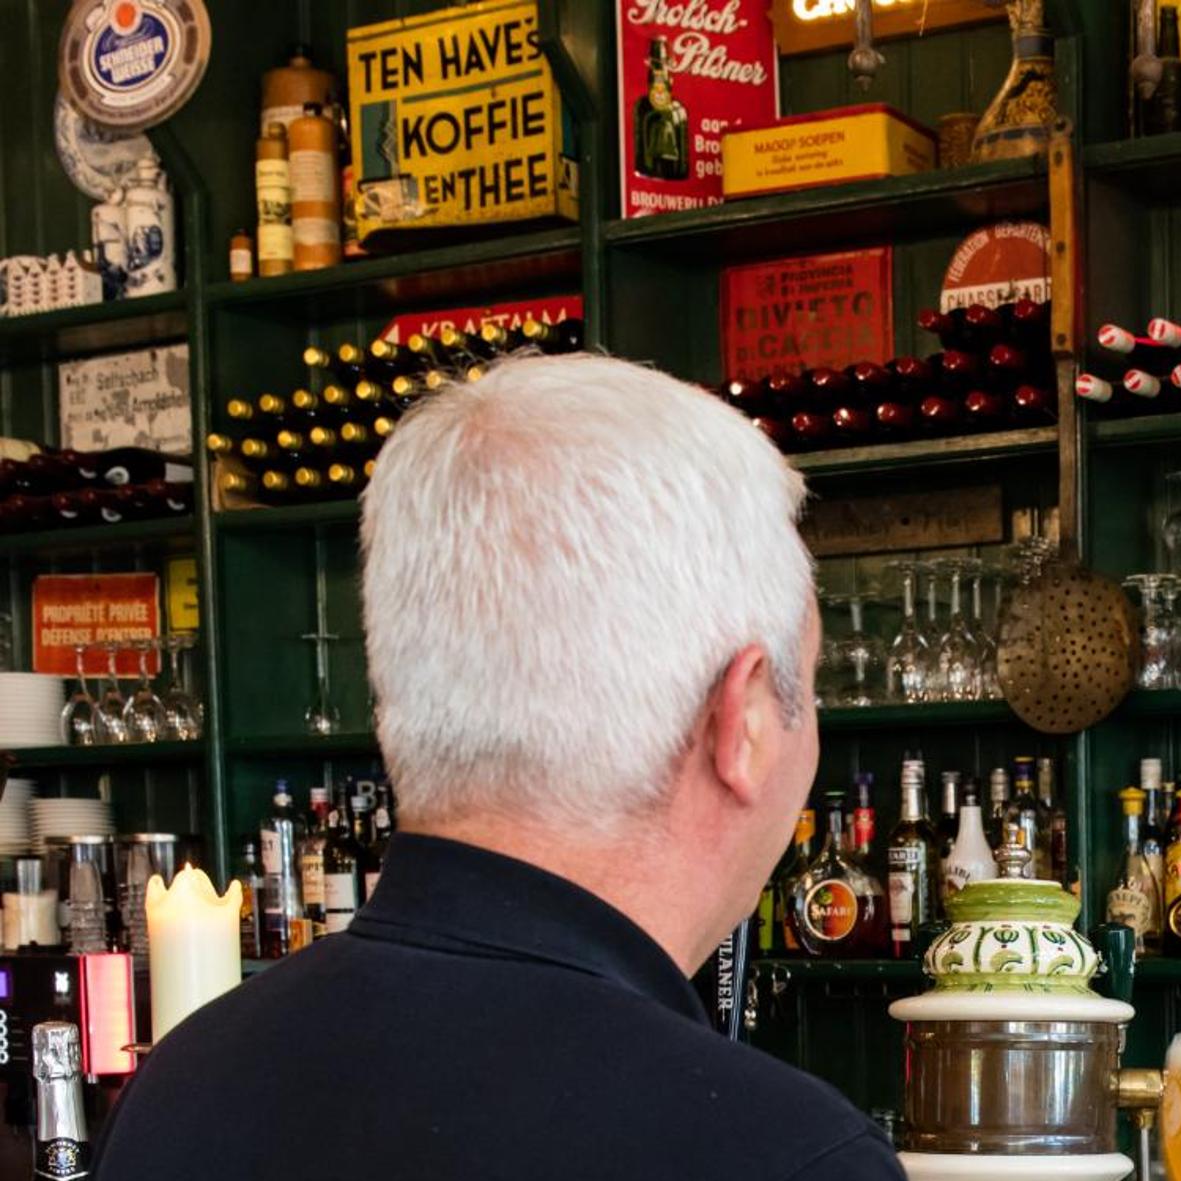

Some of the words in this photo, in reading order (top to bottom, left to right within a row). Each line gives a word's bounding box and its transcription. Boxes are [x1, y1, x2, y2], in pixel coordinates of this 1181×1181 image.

[358, 42, 424, 93] TEN
[666, 32, 767, 86] Pilsner
[402, 91, 545, 160] KOFFIE
[424, 172, 456, 205] EN
[457, 152, 548, 212] THEE
